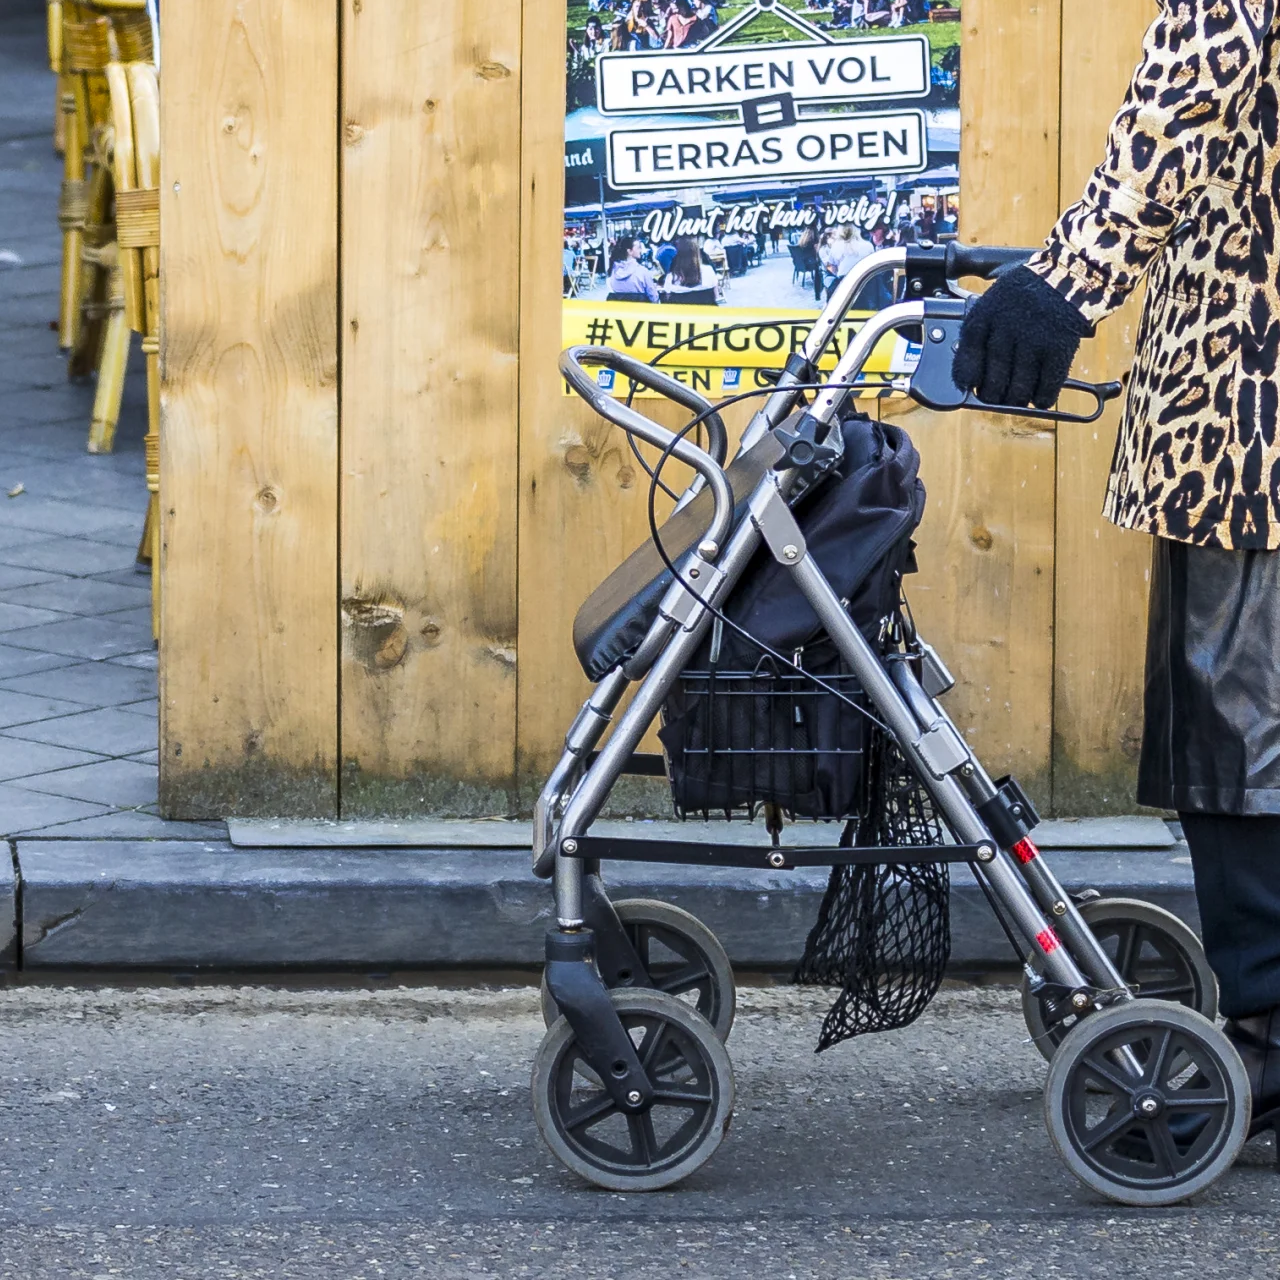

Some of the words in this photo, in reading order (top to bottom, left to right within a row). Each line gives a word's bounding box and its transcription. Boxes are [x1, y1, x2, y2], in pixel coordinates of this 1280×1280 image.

[631, 60, 795, 97] PARKEN
[807, 56, 891, 85] VOL
[625, 136, 783, 173] TERRAS
[796, 128, 909, 162] OPEN
[642, 202, 724, 243] Want
[724, 202, 766, 235] het
[767, 200, 819, 229] kan
[824, 190, 898, 231] veilig!
[585, 318, 861, 355] #VEILIGOP
